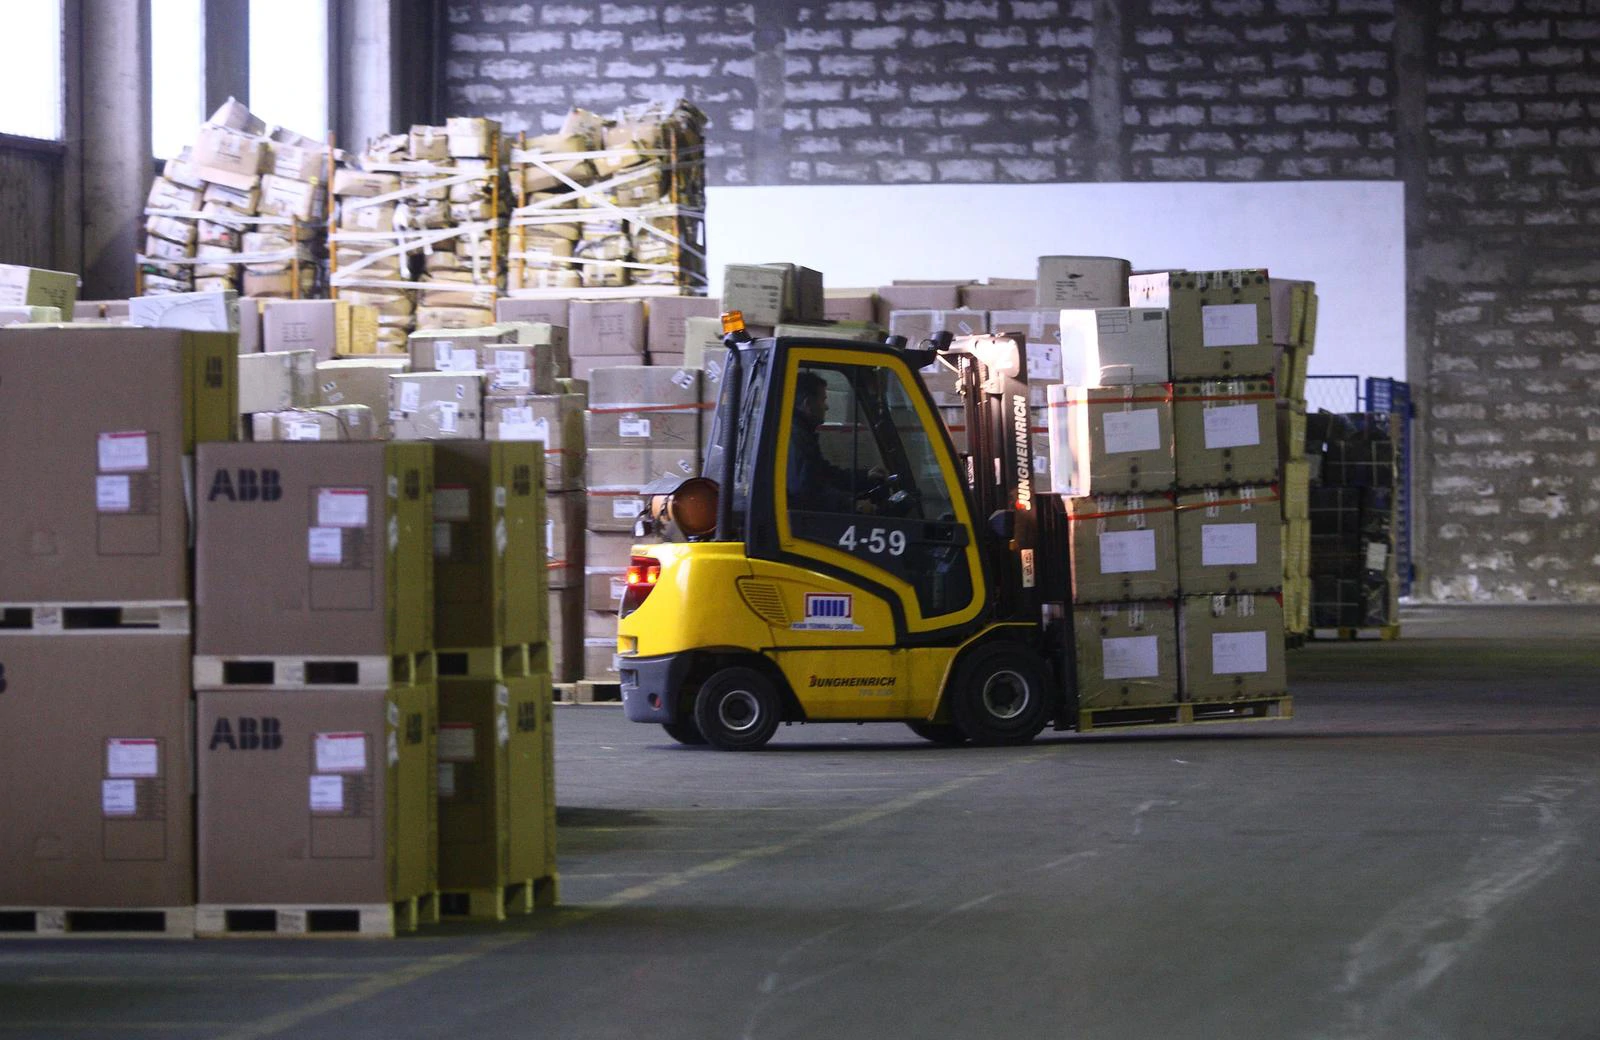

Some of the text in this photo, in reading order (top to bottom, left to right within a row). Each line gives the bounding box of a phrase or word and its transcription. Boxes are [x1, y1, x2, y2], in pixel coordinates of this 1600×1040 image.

[1013, 394, 1032, 511] JUNGHEINRICH
[207, 468, 283, 502] ABB
[839, 525, 906, 556] 4-59
[808, 674, 897, 688] JUNGHEINRICH
[209, 716, 284, 751] ABB
